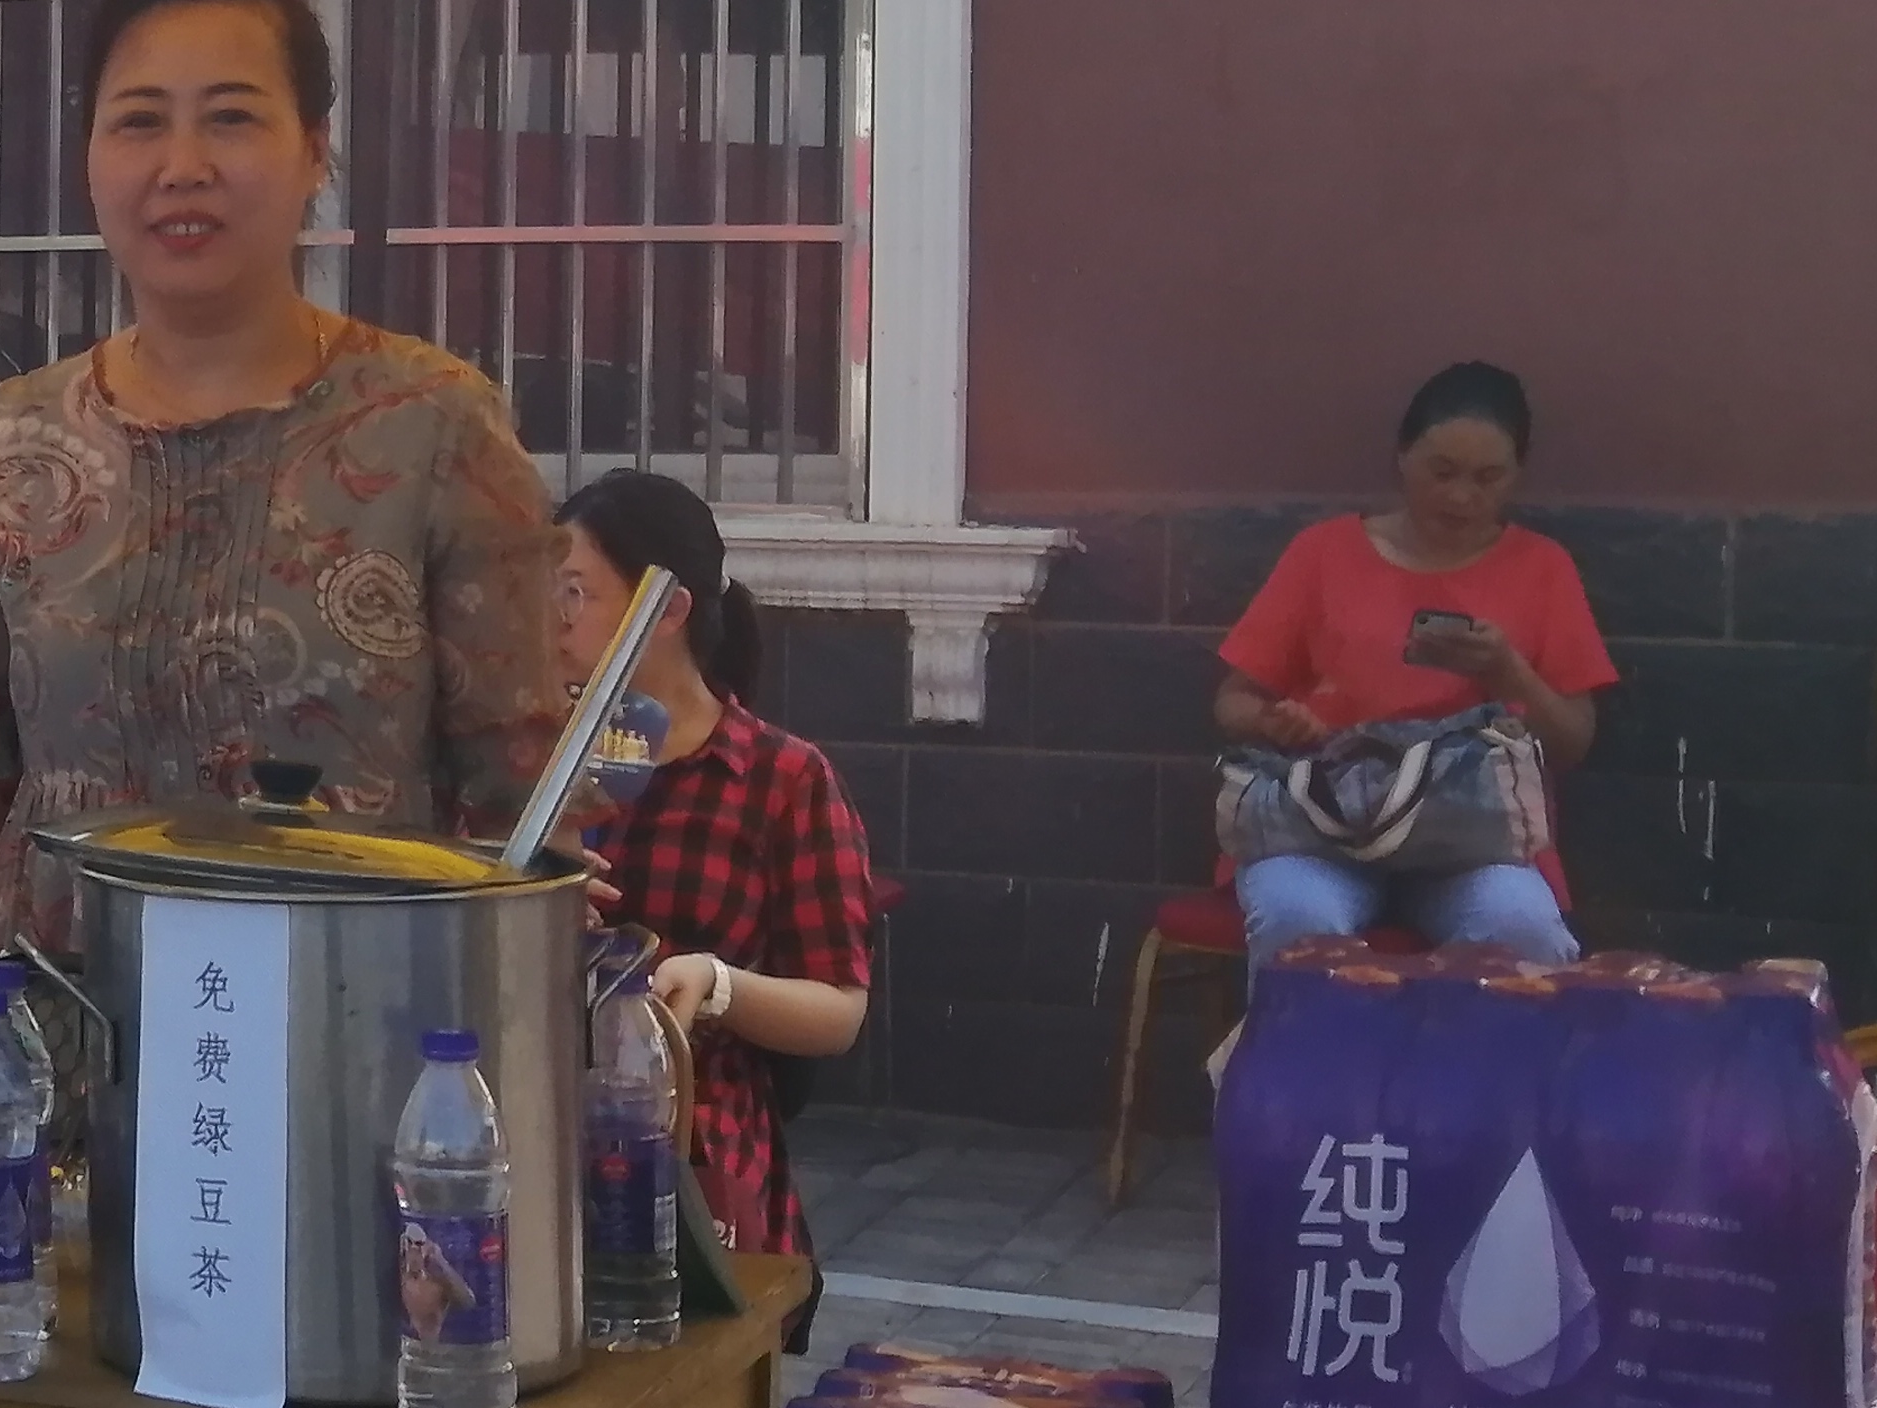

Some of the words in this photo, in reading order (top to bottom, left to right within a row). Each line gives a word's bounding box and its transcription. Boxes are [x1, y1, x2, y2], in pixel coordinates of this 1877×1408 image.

[191, 960, 235, 1298] 免费绿豆茶
[1287, 1133, 1410, 1382] 纯悦
